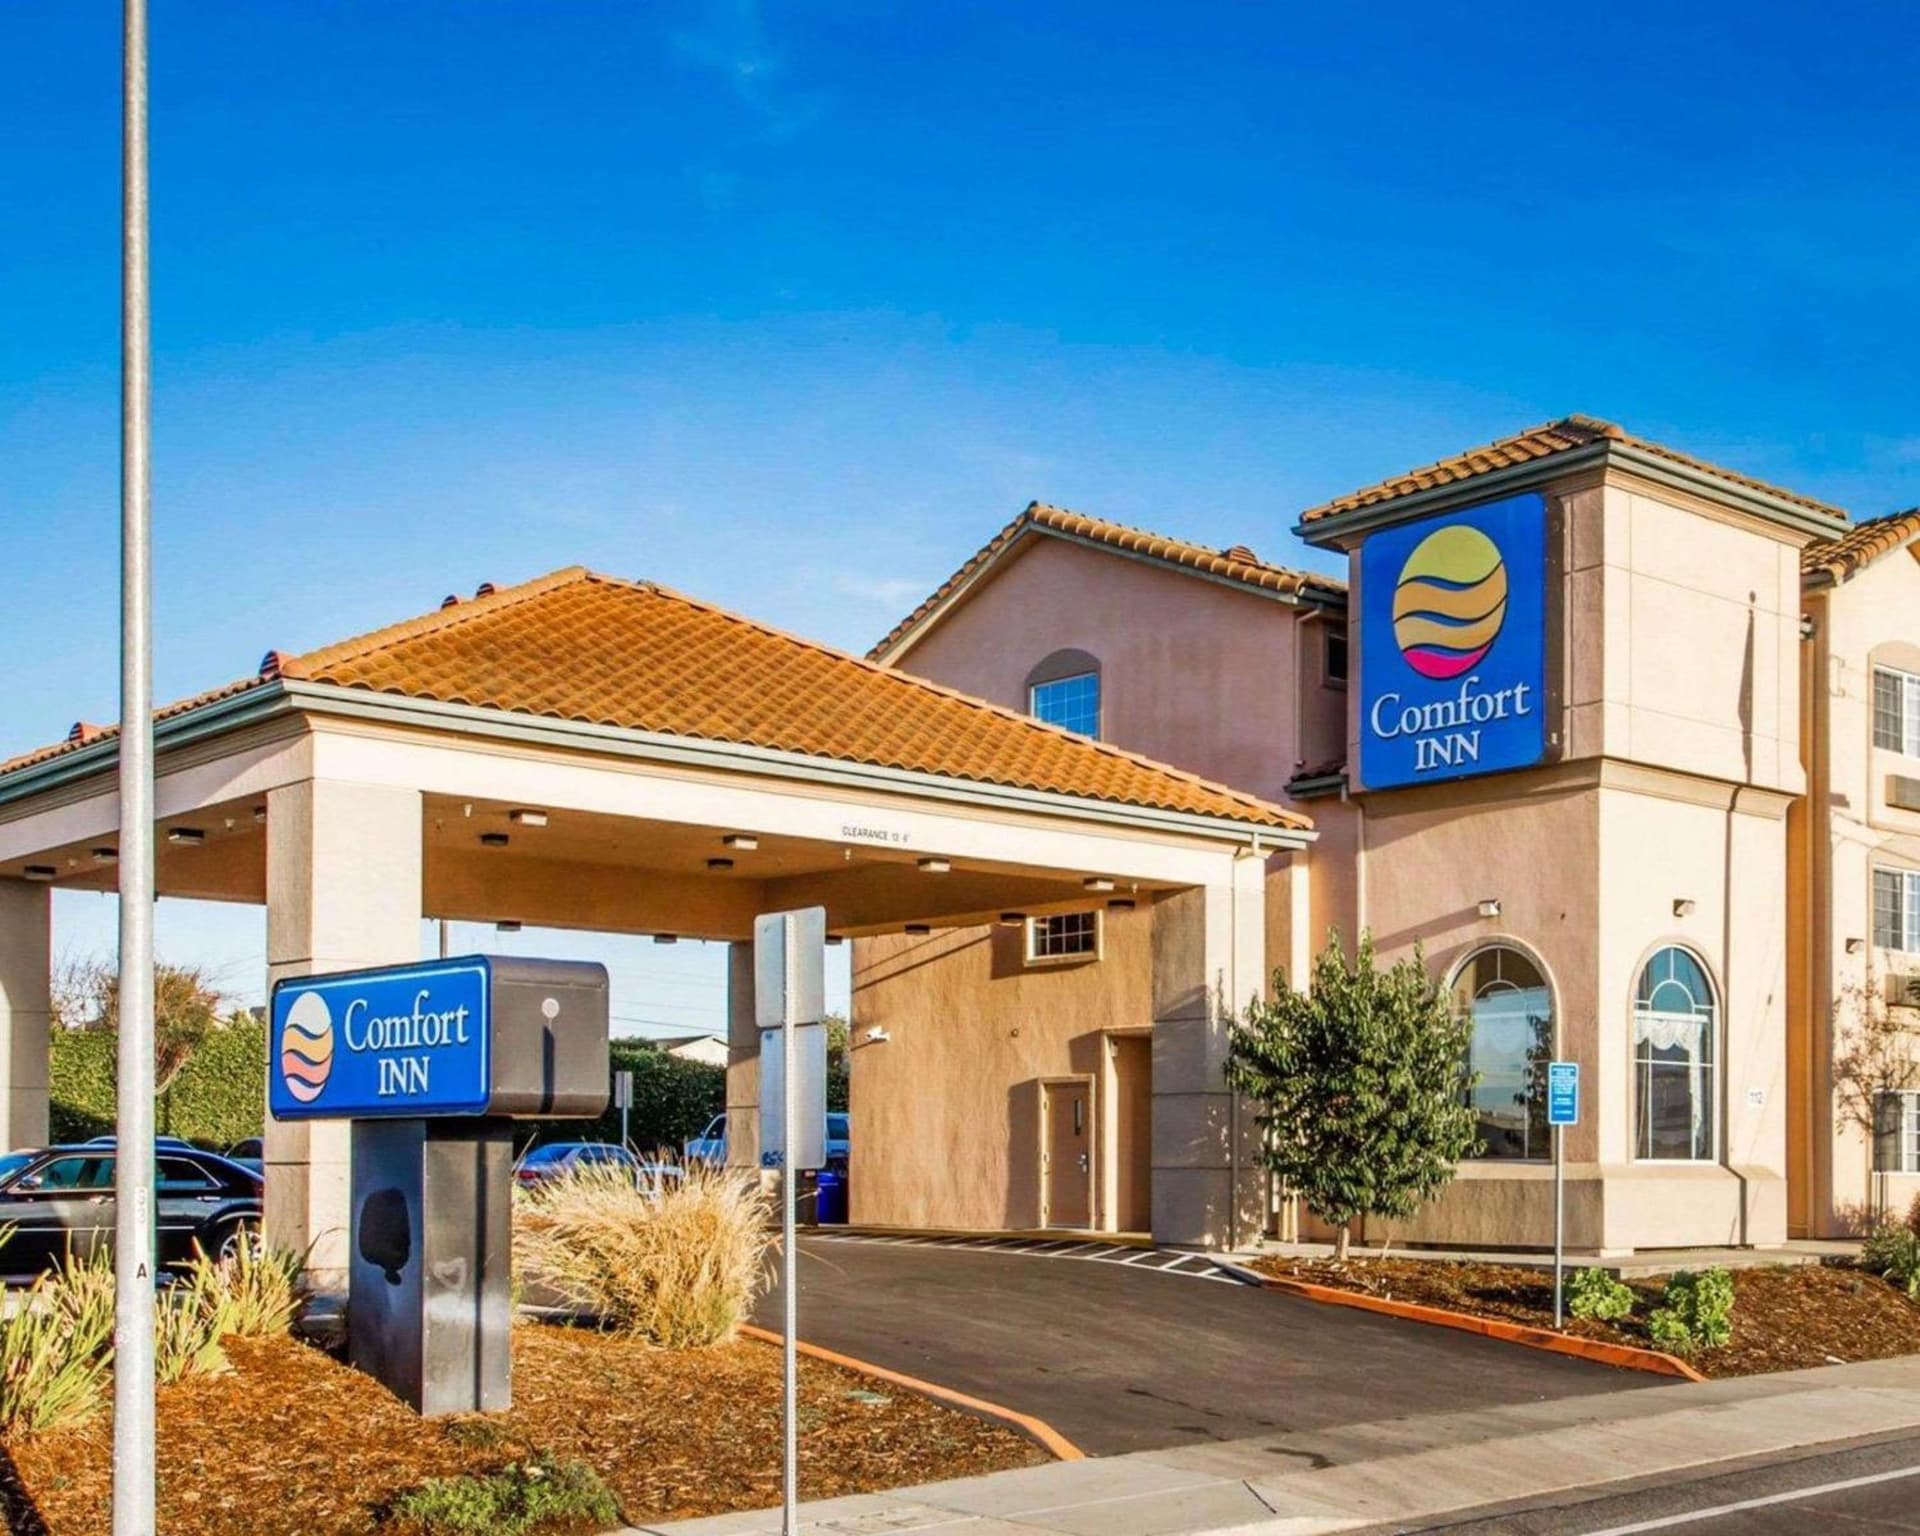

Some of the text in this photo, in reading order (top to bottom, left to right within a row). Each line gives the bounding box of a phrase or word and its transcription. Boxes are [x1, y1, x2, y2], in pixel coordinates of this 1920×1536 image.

[1371, 675, 1531, 738] Comfort
[1414, 730, 1481, 771] INN
[841, 826, 888, 841] CLEARANCE
[344, 989, 469, 1051] Comfort
[378, 1056, 430, 1096] INN
[136, 1262, 147, 1279] A
